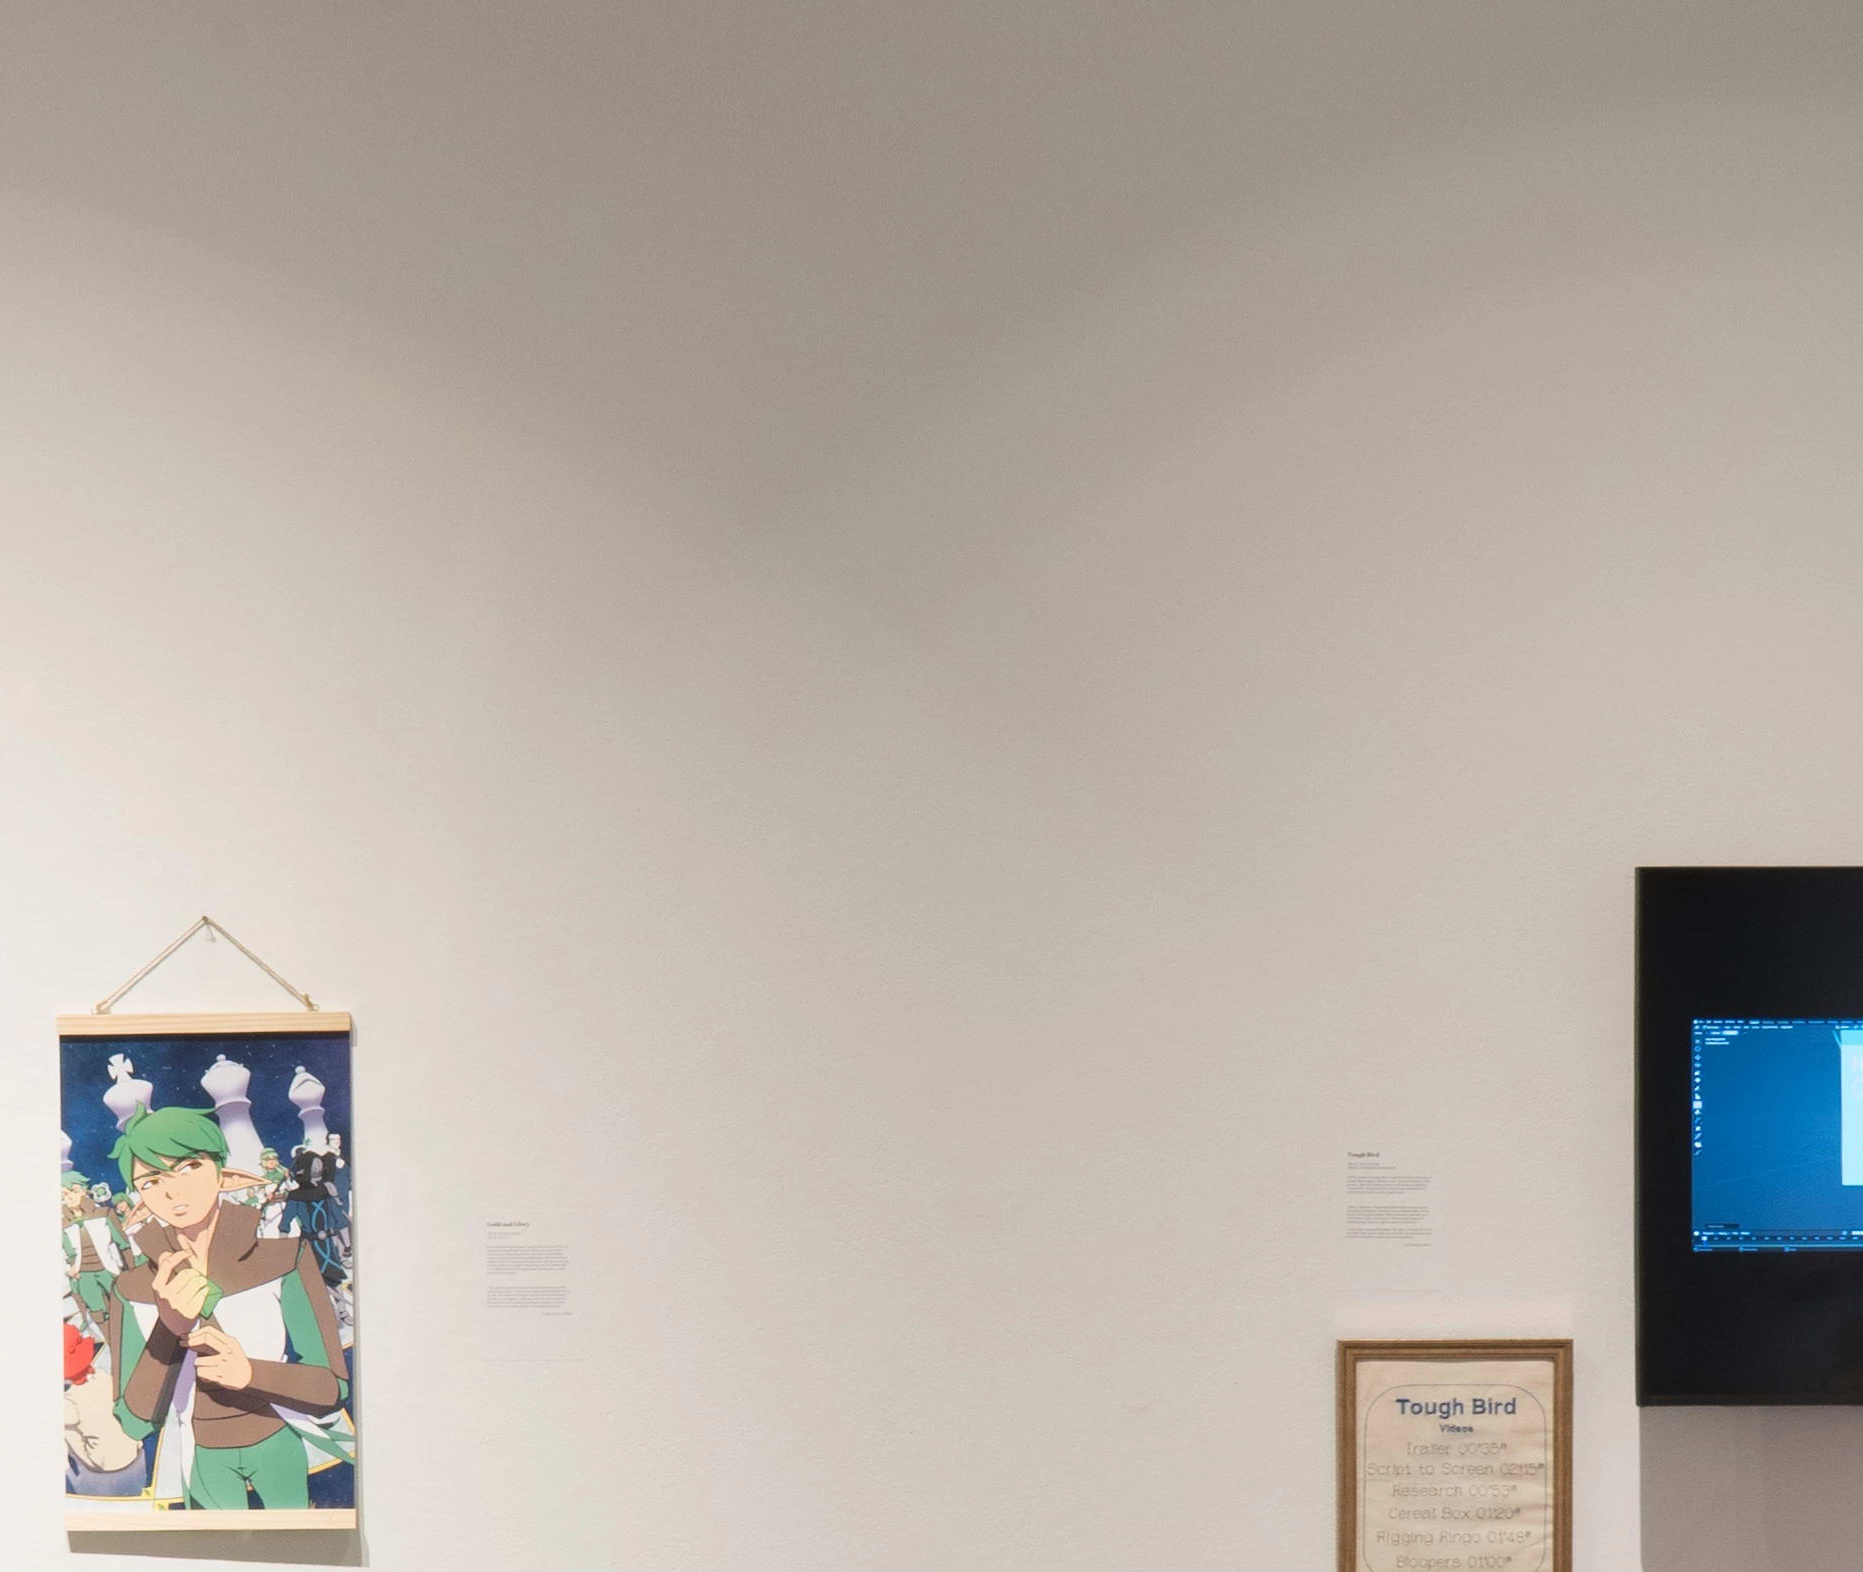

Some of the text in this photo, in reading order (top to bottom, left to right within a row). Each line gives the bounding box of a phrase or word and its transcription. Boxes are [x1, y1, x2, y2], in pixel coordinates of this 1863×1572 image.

[1395, 1397, 1517, 1419] Tough Bird
[1440, 1424, 1474, 1433] Videos
[1366, 1462, 1413, 1477] Script
[1419, 1463, 1435, 1476] to
[1441, 1462, 1494, 1476] Screen
[1390, 1484, 1463, 1498] Research
[1388, 1507, 1437, 1520] Cereal
[1441, 1506, 1472, 1520] Box
[1377, 1530, 1434, 1546] Rigging
[1396, 1555, 1462, 1571] Bloopers
